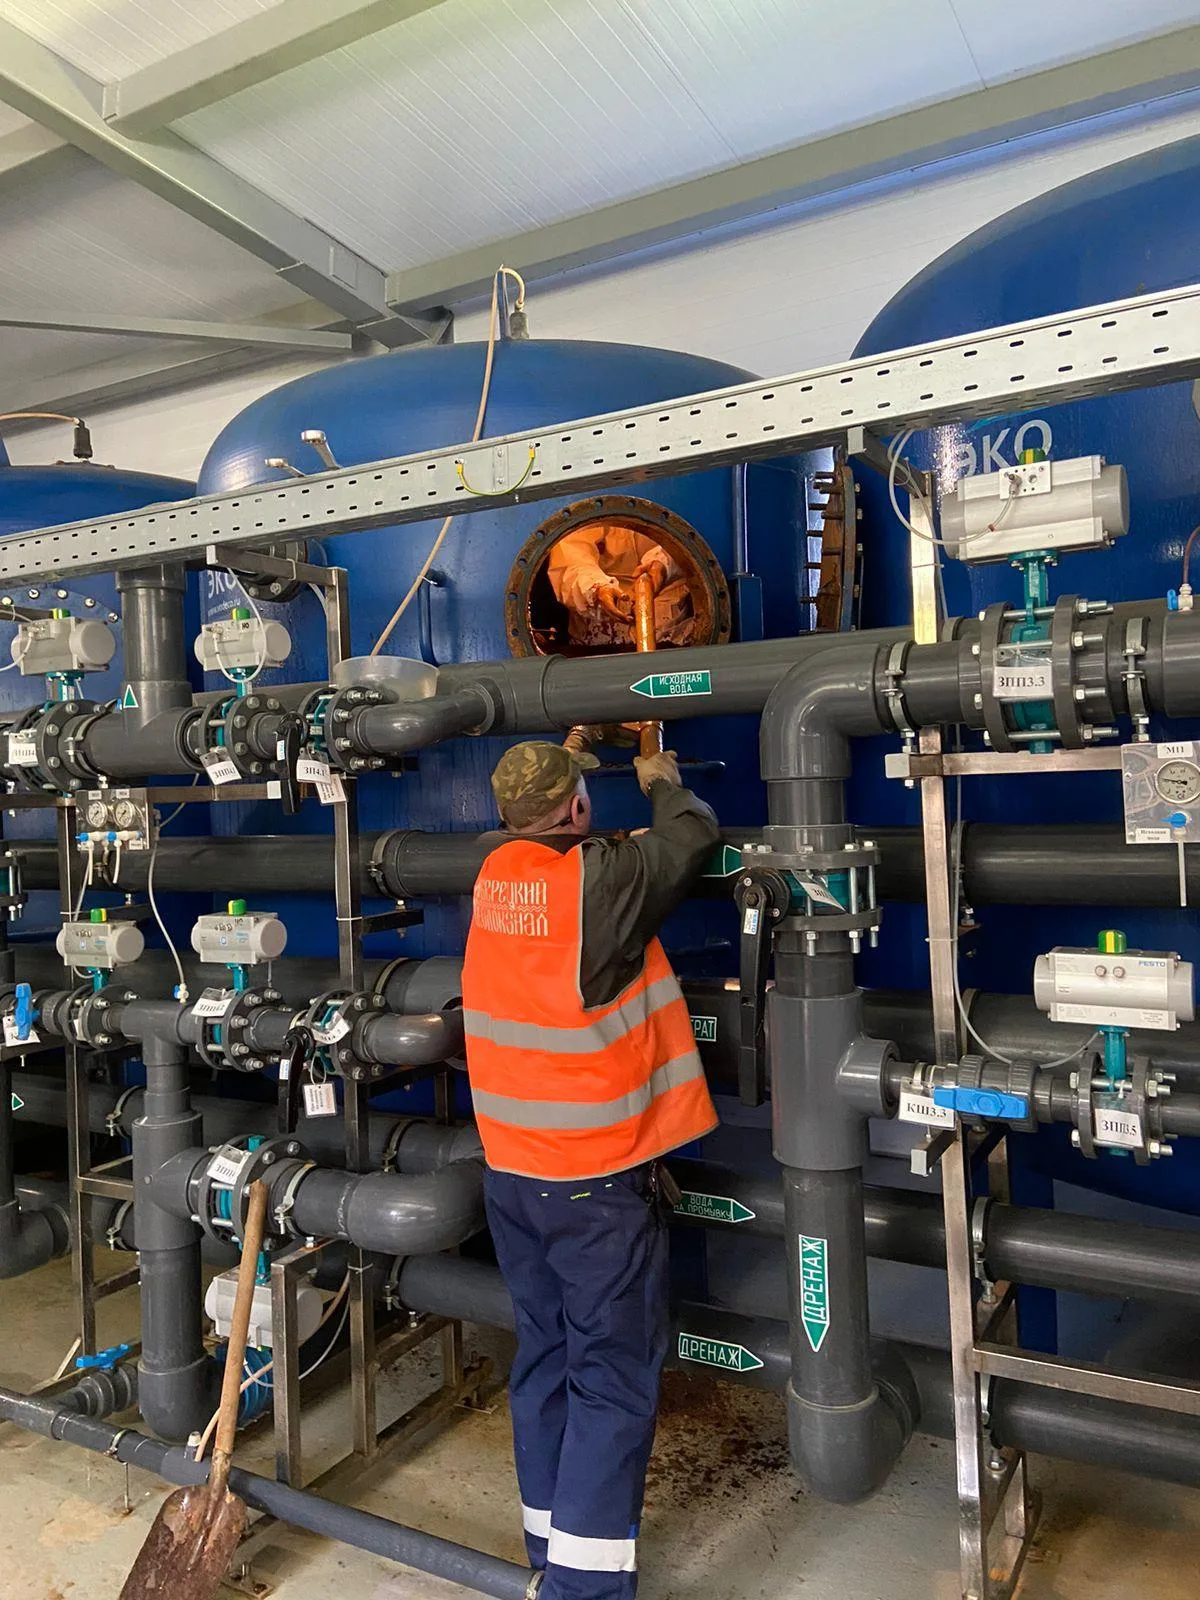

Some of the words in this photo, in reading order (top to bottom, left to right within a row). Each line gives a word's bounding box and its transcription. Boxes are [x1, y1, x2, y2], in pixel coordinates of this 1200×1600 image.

[659, 673, 703, 686] ИСХОДНАЯ
[998, 676, 1046, 688] ЗПП3.3
[669, 684, 693, 695] ВОДА
[1138, 960, 1166, 968] FESTO
[691, 1019, 714, 1037] РАТ
[907, 1102, 947, 1117] КШ3.3
[690, 1195, 713, 1207] ВОДА
[688, 1205, 732, 1220] ПРОМЫВКУ
[803, 1238, 826, 1320] ДРЕНАЖ
[680, 1338, 739, 1367] ДРЕНАЖ
